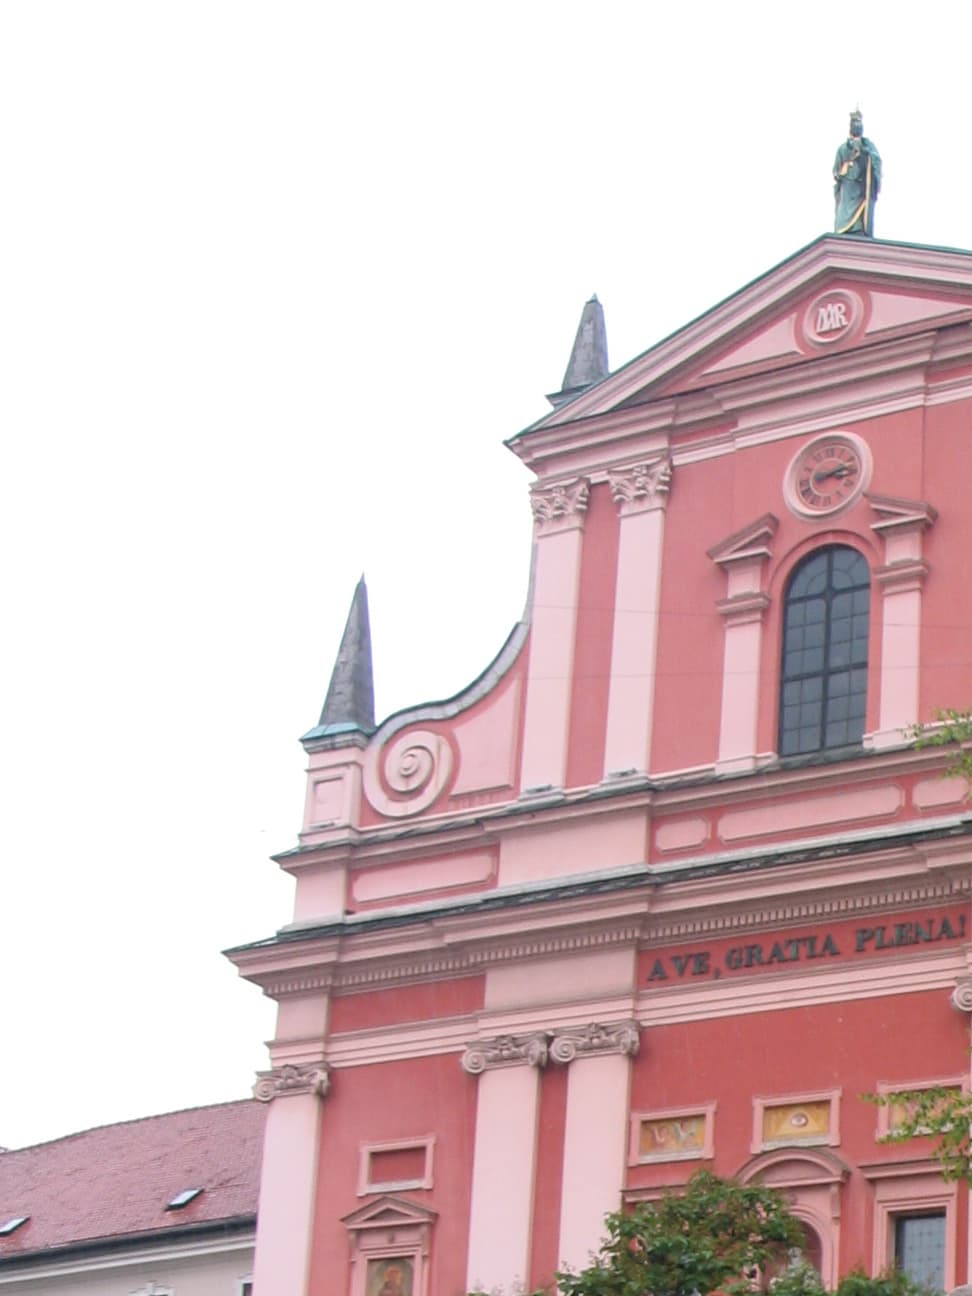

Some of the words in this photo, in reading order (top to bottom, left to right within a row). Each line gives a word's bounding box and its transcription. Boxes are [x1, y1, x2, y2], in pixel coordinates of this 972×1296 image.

[647, 951, 721, 981] AVE,
[725, 933, 841, 970] GRATIA
[854, 914, 966, 953] PLENA!
